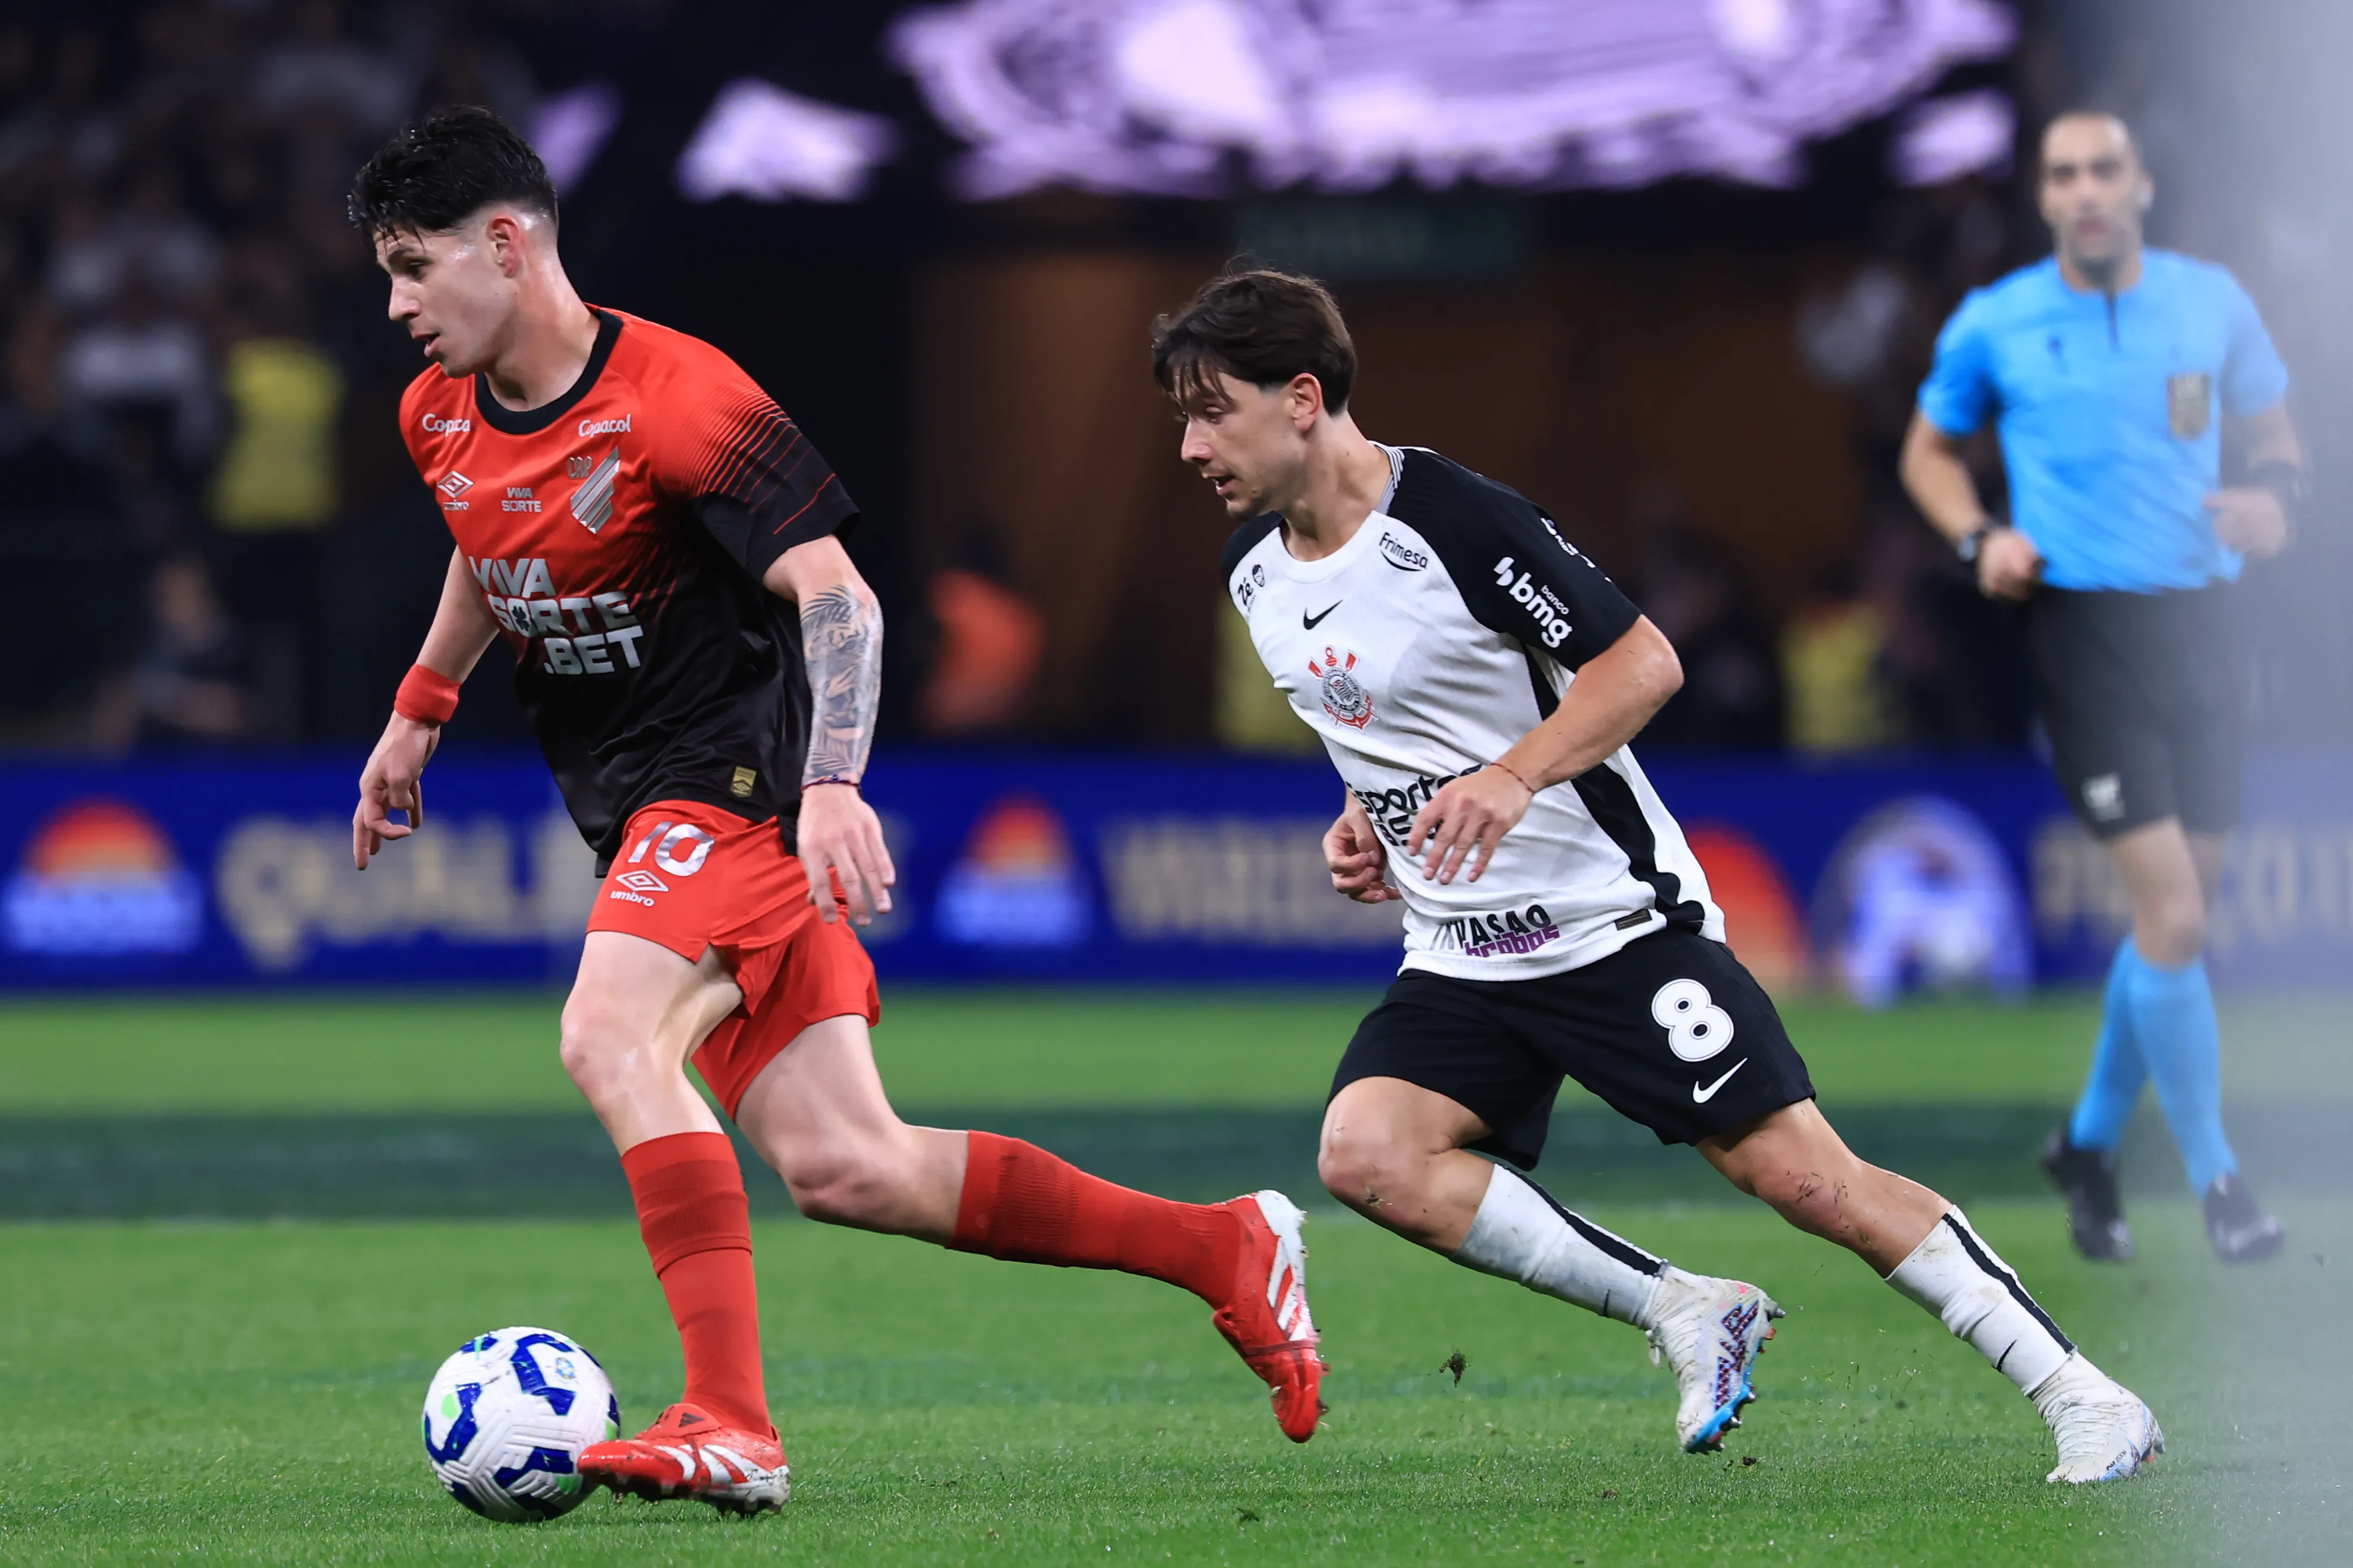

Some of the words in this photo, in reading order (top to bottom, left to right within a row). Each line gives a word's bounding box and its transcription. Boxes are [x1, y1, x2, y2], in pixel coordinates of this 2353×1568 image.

[578, 414, 632, 437] Copacol
[502, 500, 541, 513] SORTE
[507, 487, 533, 499] VIVA
[1379, 531, 1428, 569] Frimesa
[468, 556, 556, 598] VIVA
[1237, 576, 1253, 607] Zé
[487, 591, 640, 638] SORTE
[1508, 572, 1573, 648] bmg
[1541, 585, 1569, 615] banco
[543, 625, 644, 675] .BET
[628, 821, 715, 876] 10
[610, 890, 654, 907] umbro
[1651, 978, 1734, 1062] 8
